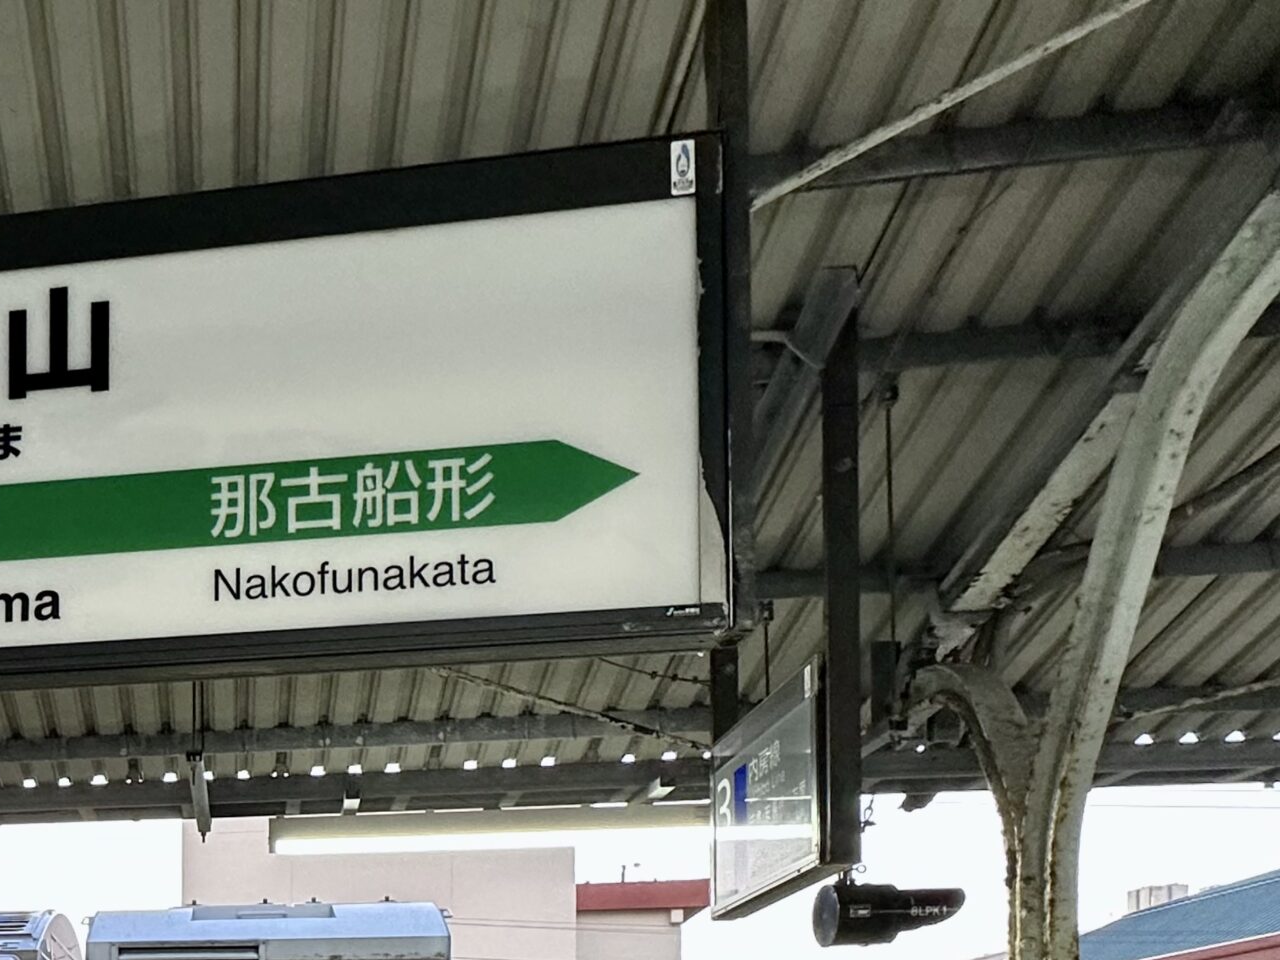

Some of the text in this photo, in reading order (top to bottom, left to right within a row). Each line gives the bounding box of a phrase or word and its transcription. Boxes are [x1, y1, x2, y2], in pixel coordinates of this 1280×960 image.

[210, 453, 496, 538] 那古船形
[213, 554, 497, 602] Nakofunakata
